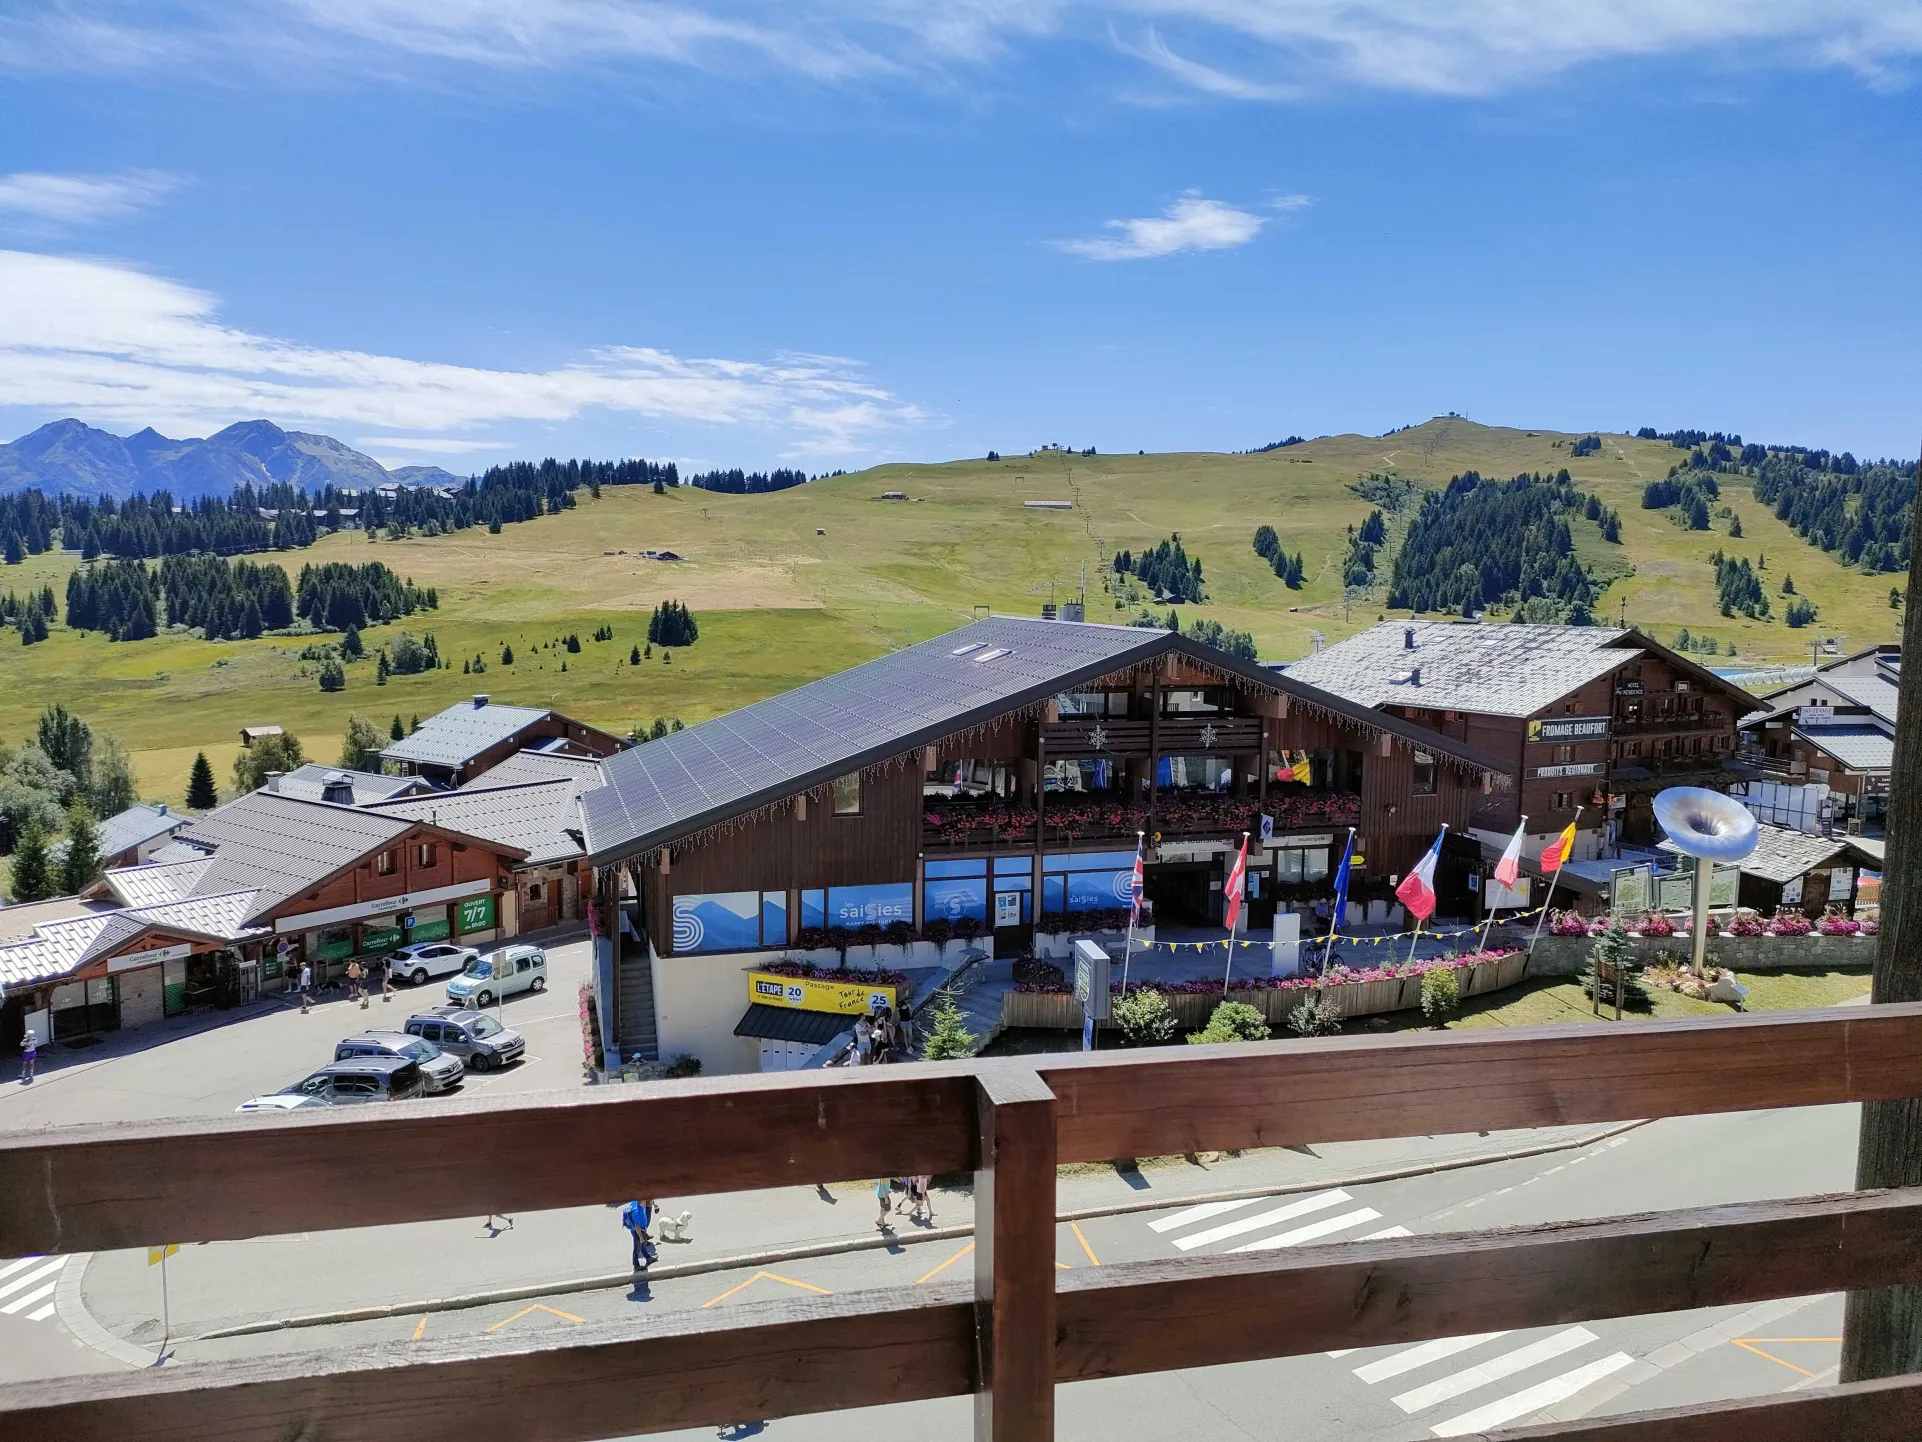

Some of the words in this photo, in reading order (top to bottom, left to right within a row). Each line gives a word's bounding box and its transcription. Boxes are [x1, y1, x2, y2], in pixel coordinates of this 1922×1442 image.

[1542, 723, 1573, 737] FROMAGE
[1574, 722, 1607, 735] BEAUFORT
[1537, 766, 1563, 778] PRODUITS
[1565, 764, 1595, 775] REGIONAUX
[371, 899, 398, 909] Carrefour
[463, 898, 486, 908] OUVERT
[463, 906, 486, 922] 7/7
[407, 918, 414, 927] P
[362, 937, 389, 947] Carrefour
[129, 952, 157, 962] Carrefour
[757, 981, 783, 995] L'ÉTAPE
[805, 980, 835, 991] Passage
[788, 987, 802, 997] 20
[838, 989, 855, 999] Tour
[856, 988, 865, 997] de
[838, 996, 865, 1011] France
[871, 994, 887, 1005] 25
